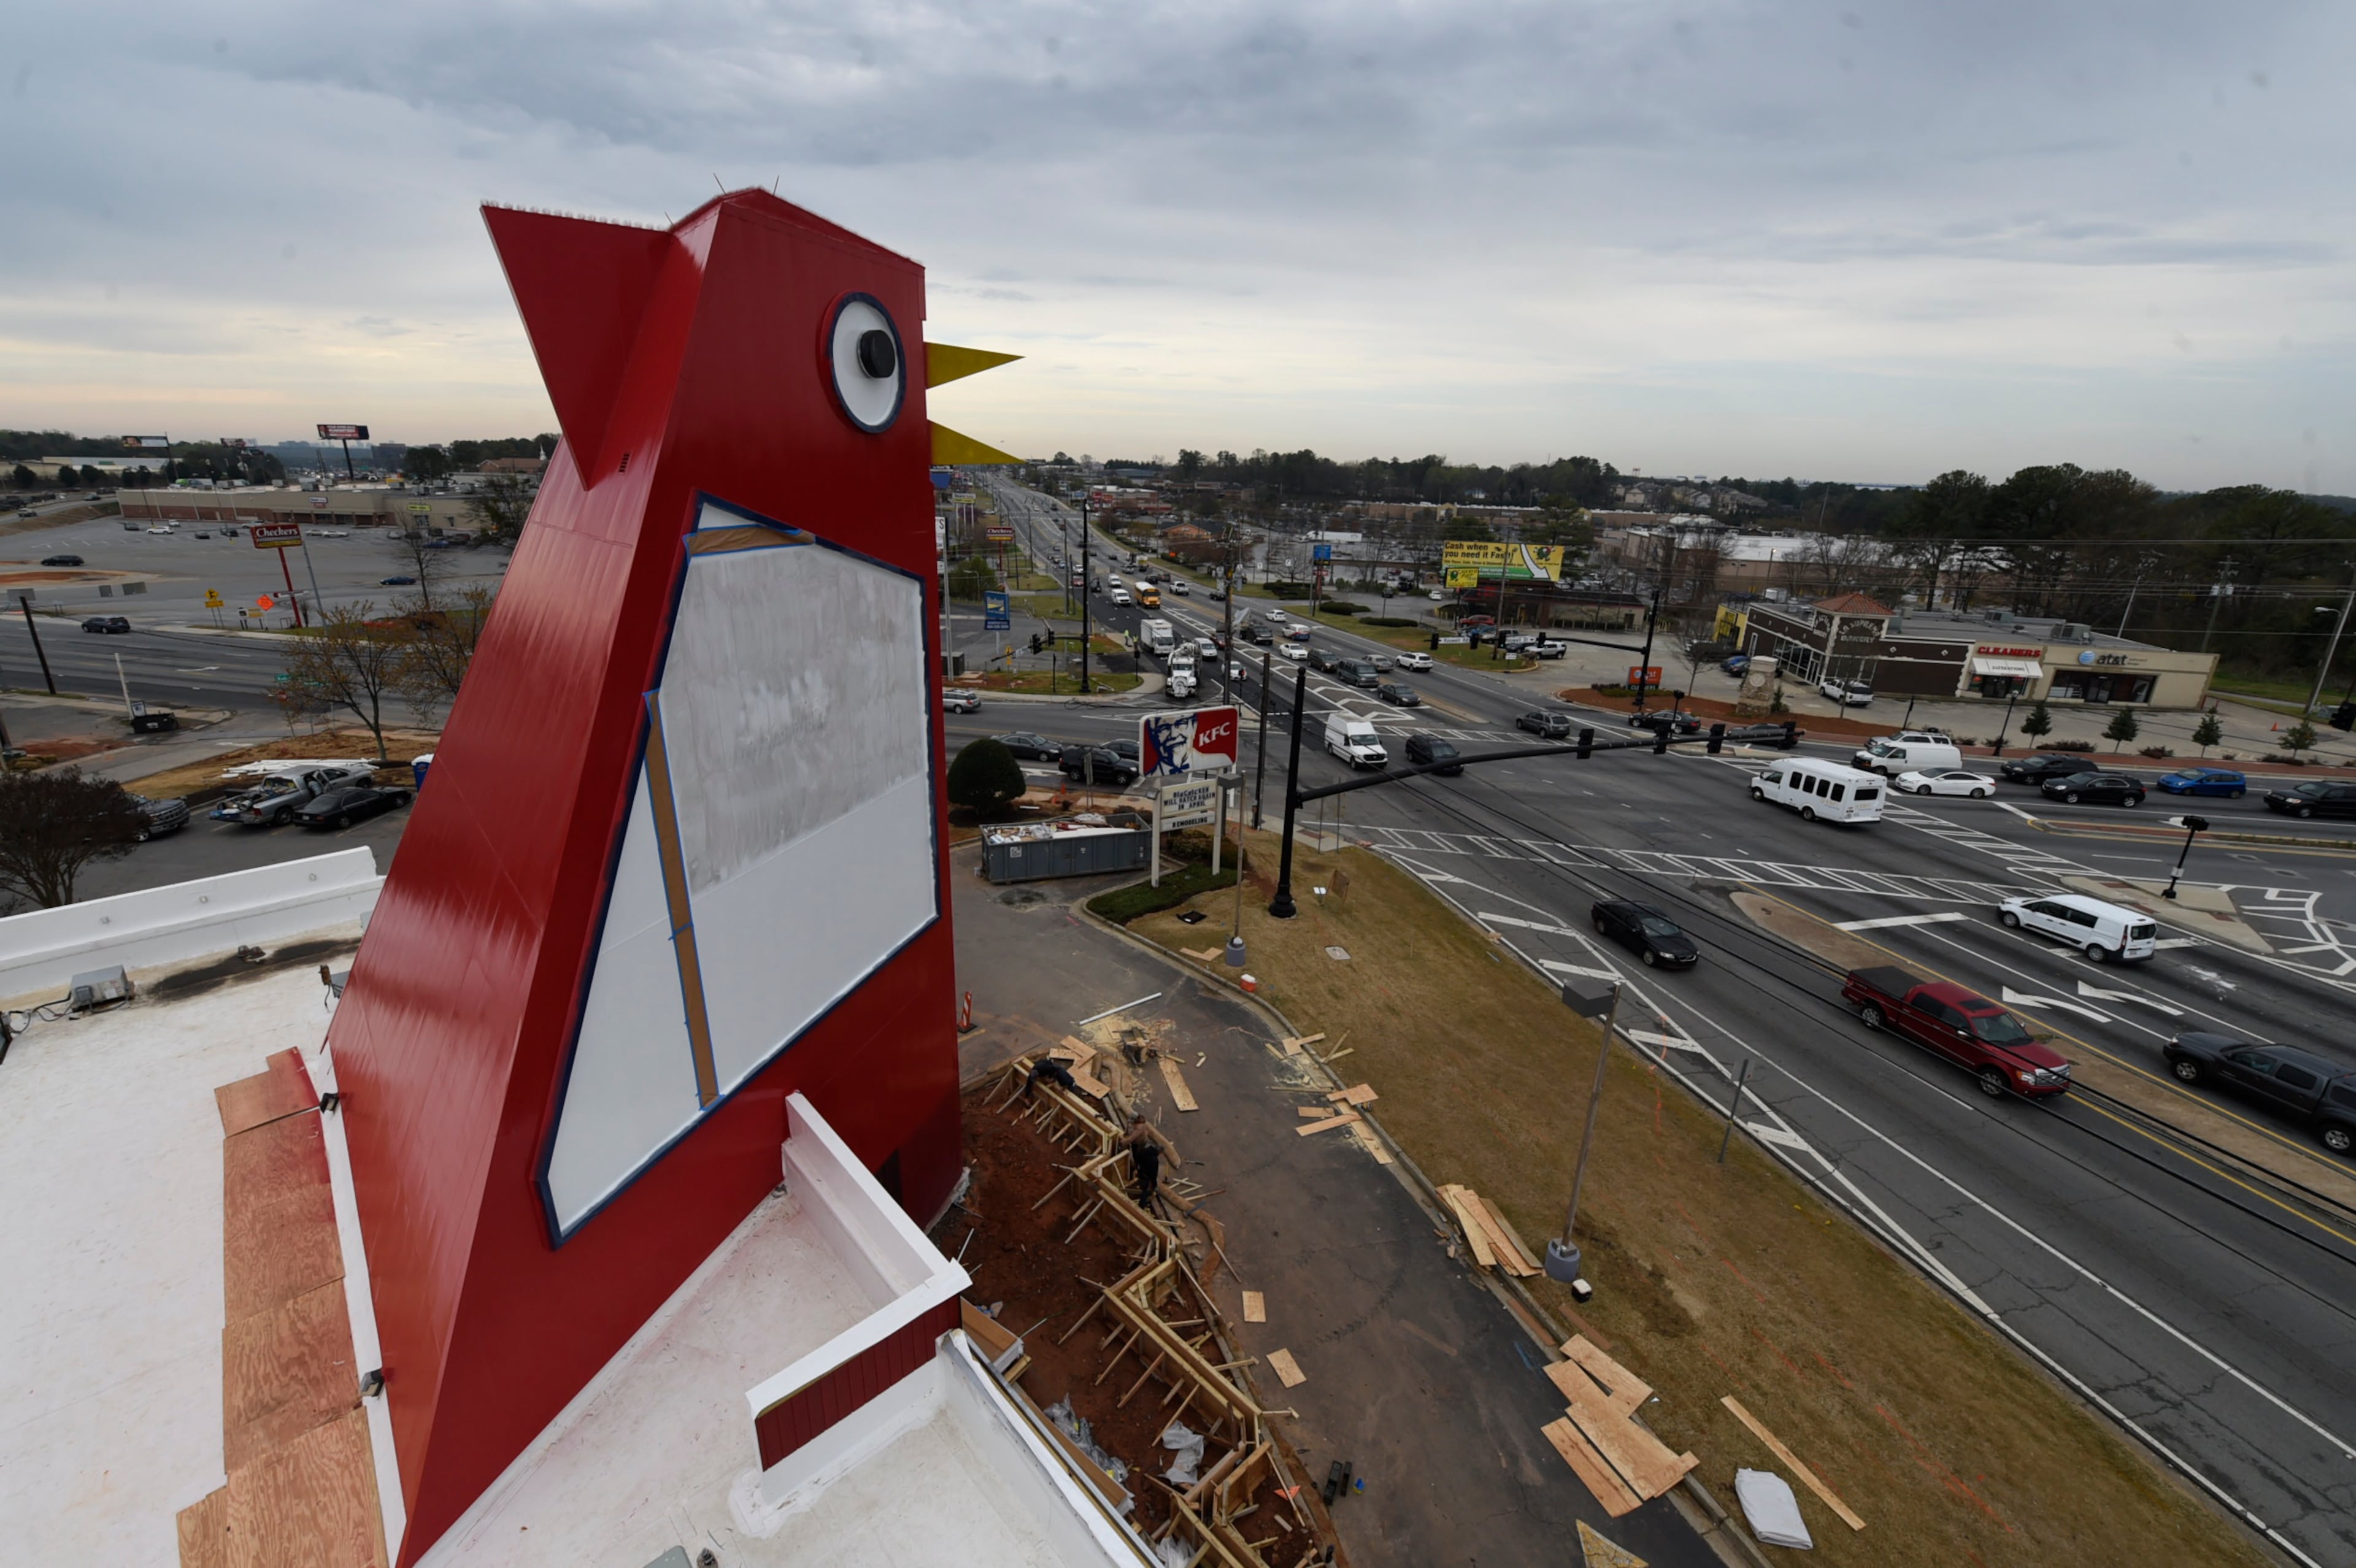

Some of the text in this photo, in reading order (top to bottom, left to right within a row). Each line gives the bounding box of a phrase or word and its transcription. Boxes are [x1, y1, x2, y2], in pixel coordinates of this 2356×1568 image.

[256, 526, 298, 537] Checkers
[1445, 542, 1465, 550] Cash
[1840, 635, 1876, 644] BAKERY
[1977, 646, 2042, 658] CLEANERS
[2096, 653, 2128, 665] at&t
[1198, 721, 1230, 747] KFC
[1179, 794, 1197, 803] HATCH
[1172, 817, 1207, 828] REMODELING
